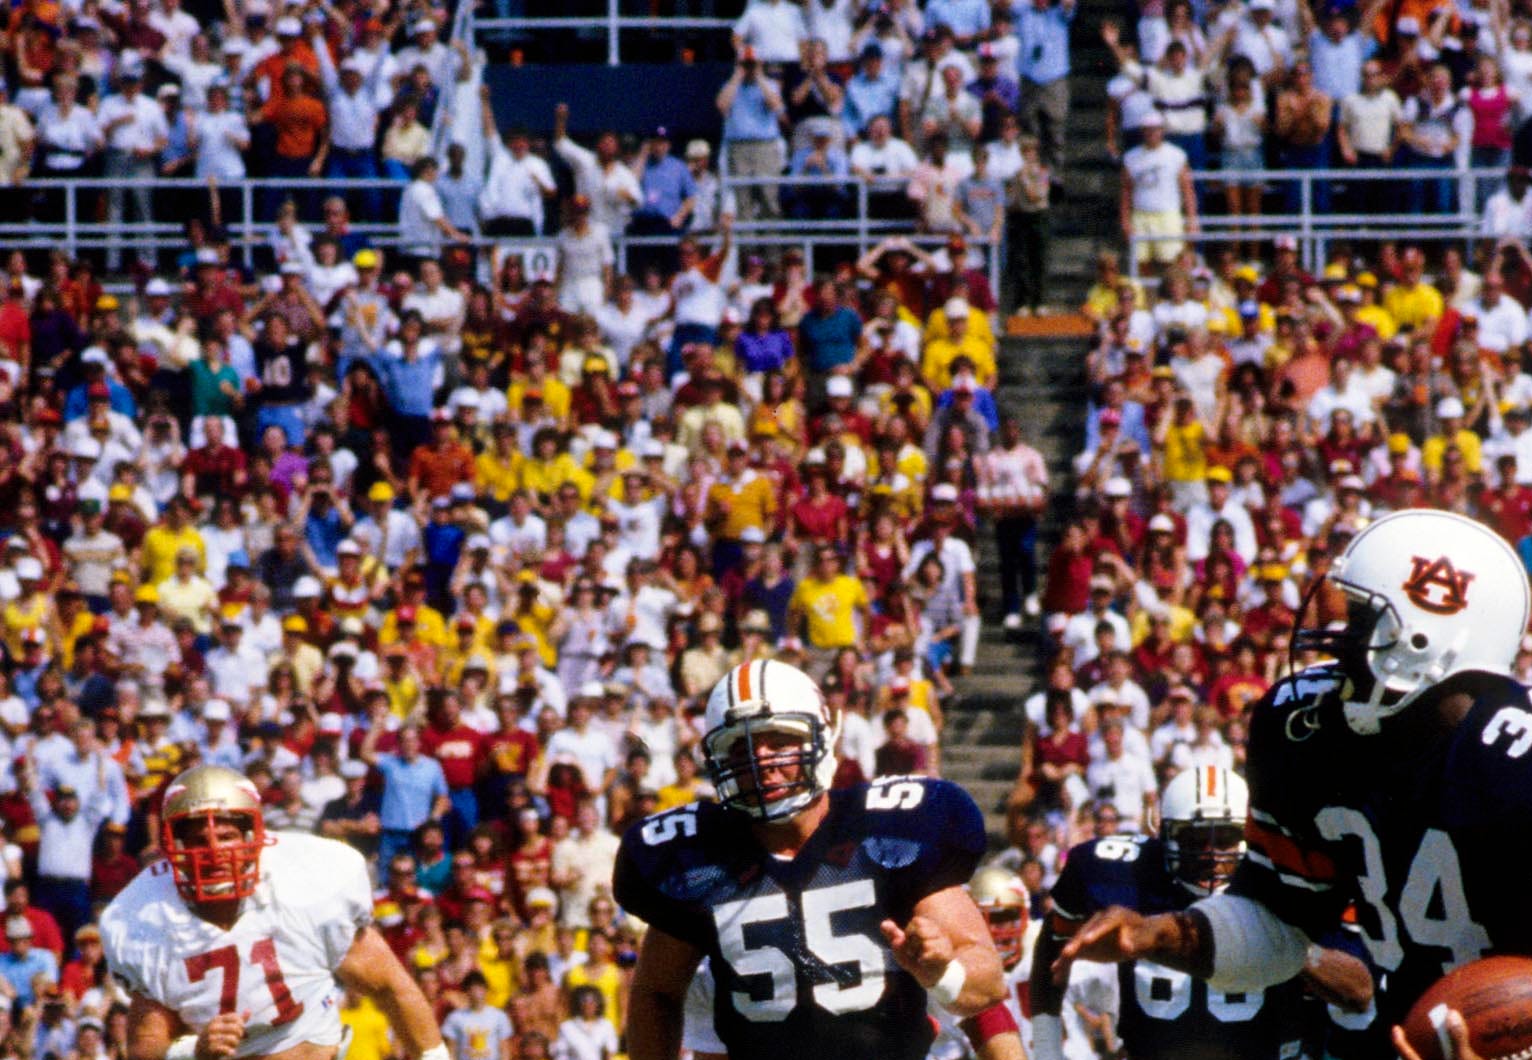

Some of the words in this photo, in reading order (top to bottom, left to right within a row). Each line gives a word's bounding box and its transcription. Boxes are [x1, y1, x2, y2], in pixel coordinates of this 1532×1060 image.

[641, 802, 699, 846] 5
[865, 774, 927, 810] 5
[1313, 806, 1494, 976] 34
[184, 938, 304, 1026] 71
[713, 879, 886, 1023] 55
